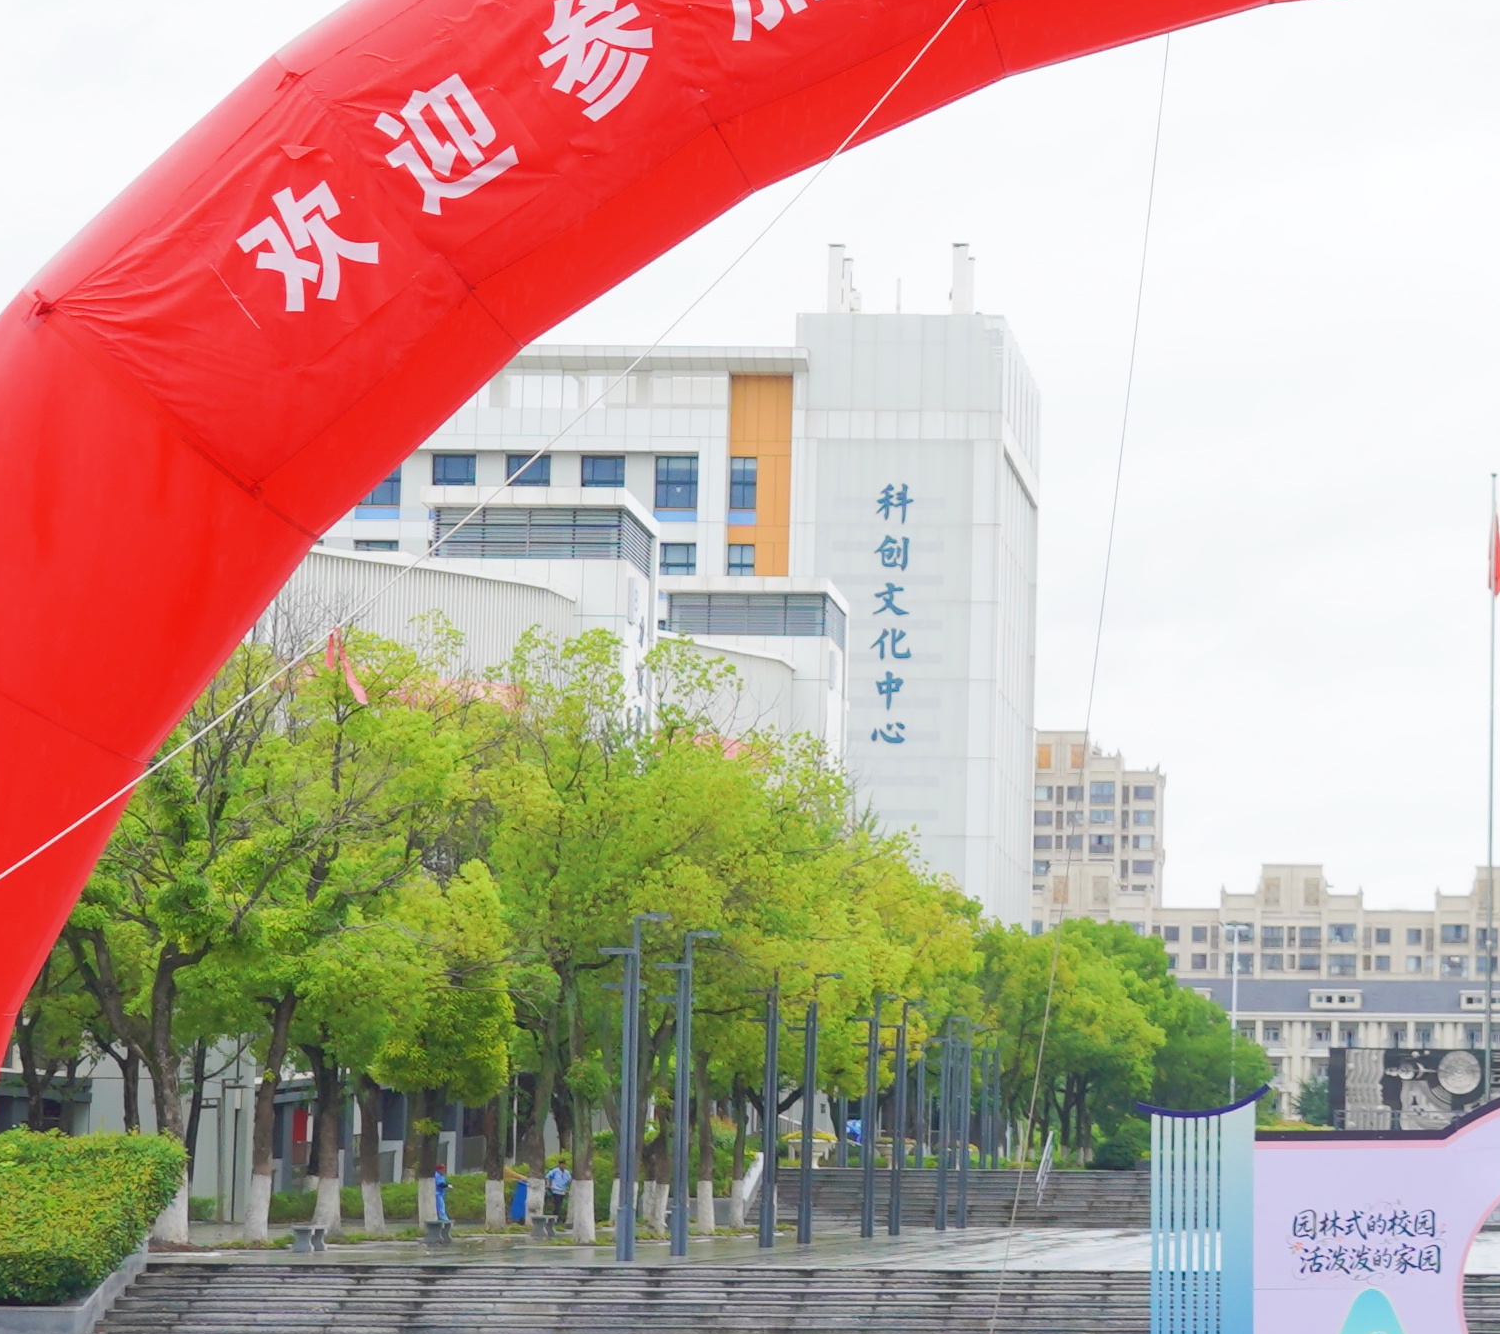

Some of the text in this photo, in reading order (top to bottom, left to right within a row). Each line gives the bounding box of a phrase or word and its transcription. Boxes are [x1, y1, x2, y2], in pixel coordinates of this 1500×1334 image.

[869, 482, 915, 745] 科创文化中心
[1292, 1209, 1436, 1240] 园林式的校园
[1300, 1243, 1442, 1275] 活泼泼的家园
